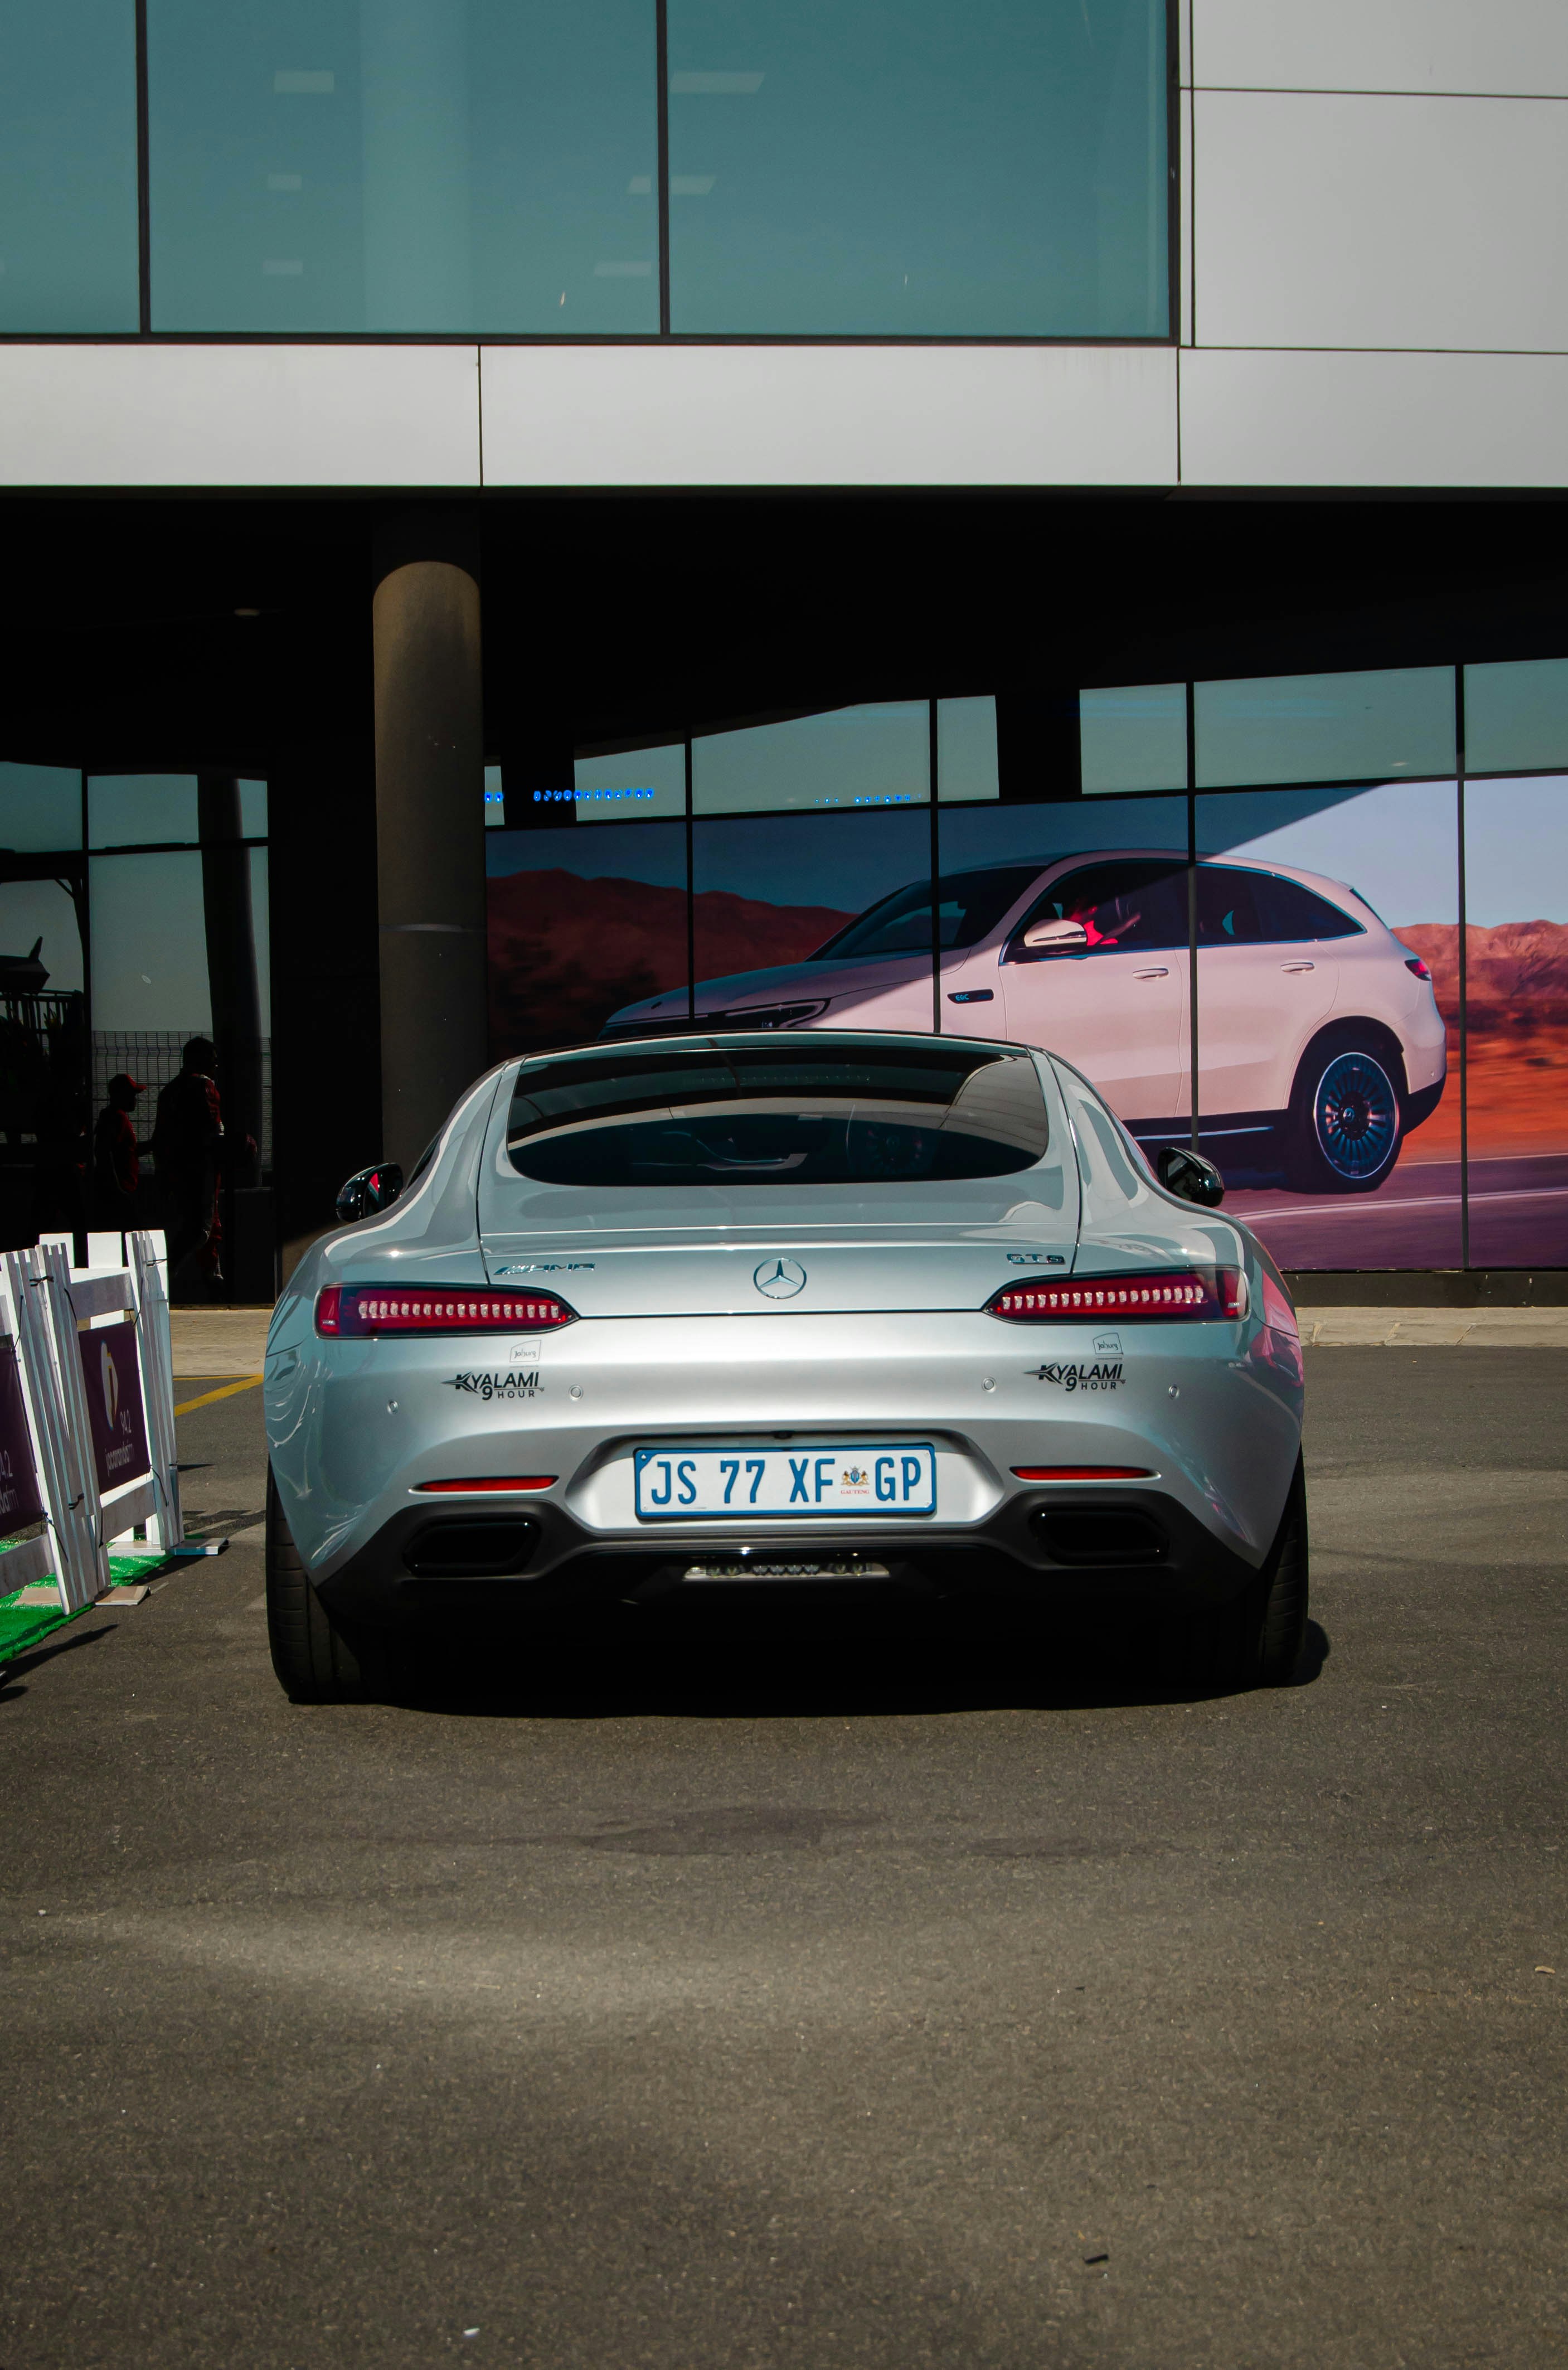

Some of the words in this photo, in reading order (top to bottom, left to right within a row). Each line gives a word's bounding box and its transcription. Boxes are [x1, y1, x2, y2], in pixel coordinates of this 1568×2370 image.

[452, 1371, 540, 1393] KYALAMI
[1035, 1362, 1123, 1385] KYALAMI
[1065, 1376, 1077, 1392] 9
[1081, 1382, 1116, 1390] HOUR
[482, 1385, 493, 1400] 9
[498, 1390, 535, 1398] HOUR
[651, 1460, 696, 1505] JS
[720, 1459, 765, 1504] 77
[789, 1458, 835, 1503] XF
[875, 1457, 921, 1501] GP
